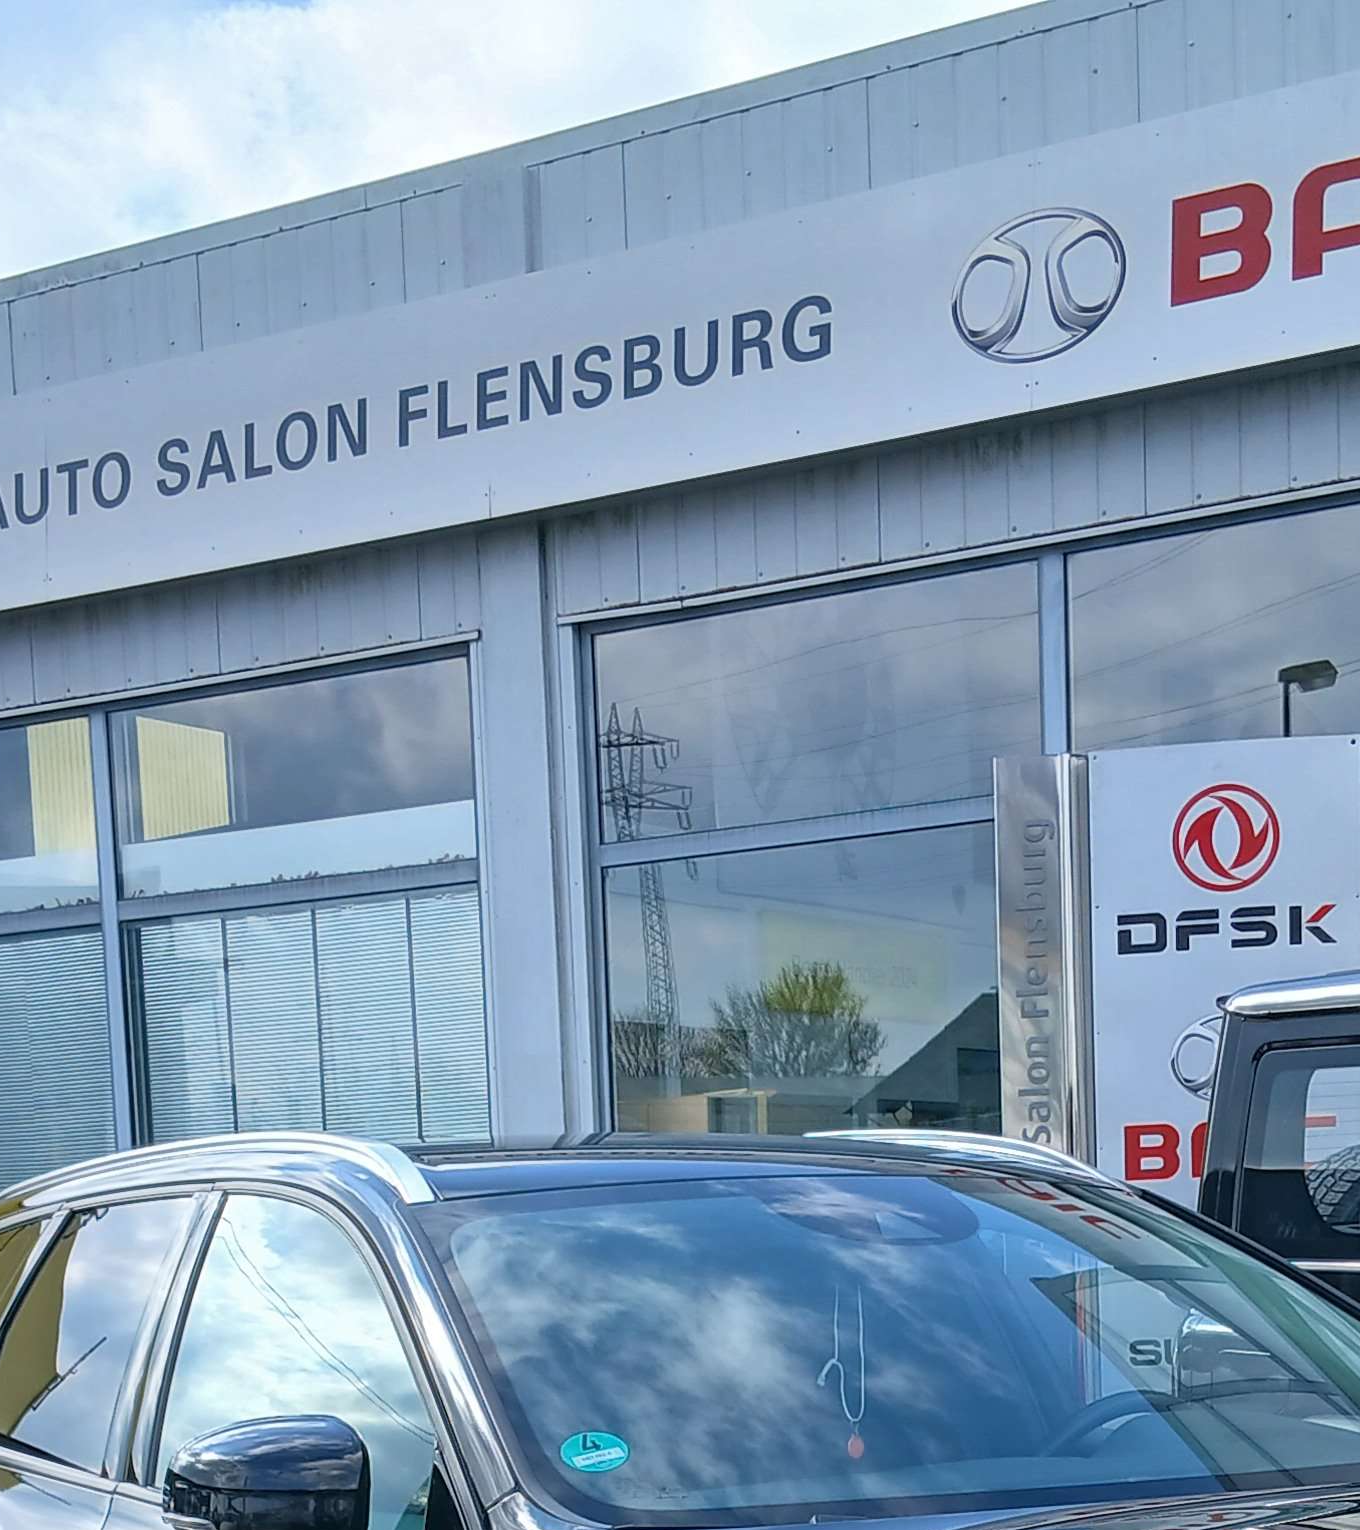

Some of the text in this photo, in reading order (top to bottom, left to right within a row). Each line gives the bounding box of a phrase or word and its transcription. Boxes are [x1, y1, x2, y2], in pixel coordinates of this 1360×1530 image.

[156, 415, 368, 497] SALON
[398, 295, 833, 447] FLENSBURG
[1016, 819, 1056, 1147] Salon Flensburg
[1116, 903, 1337, 955] DFSK
[582, 1433, 602, 1451] 4
